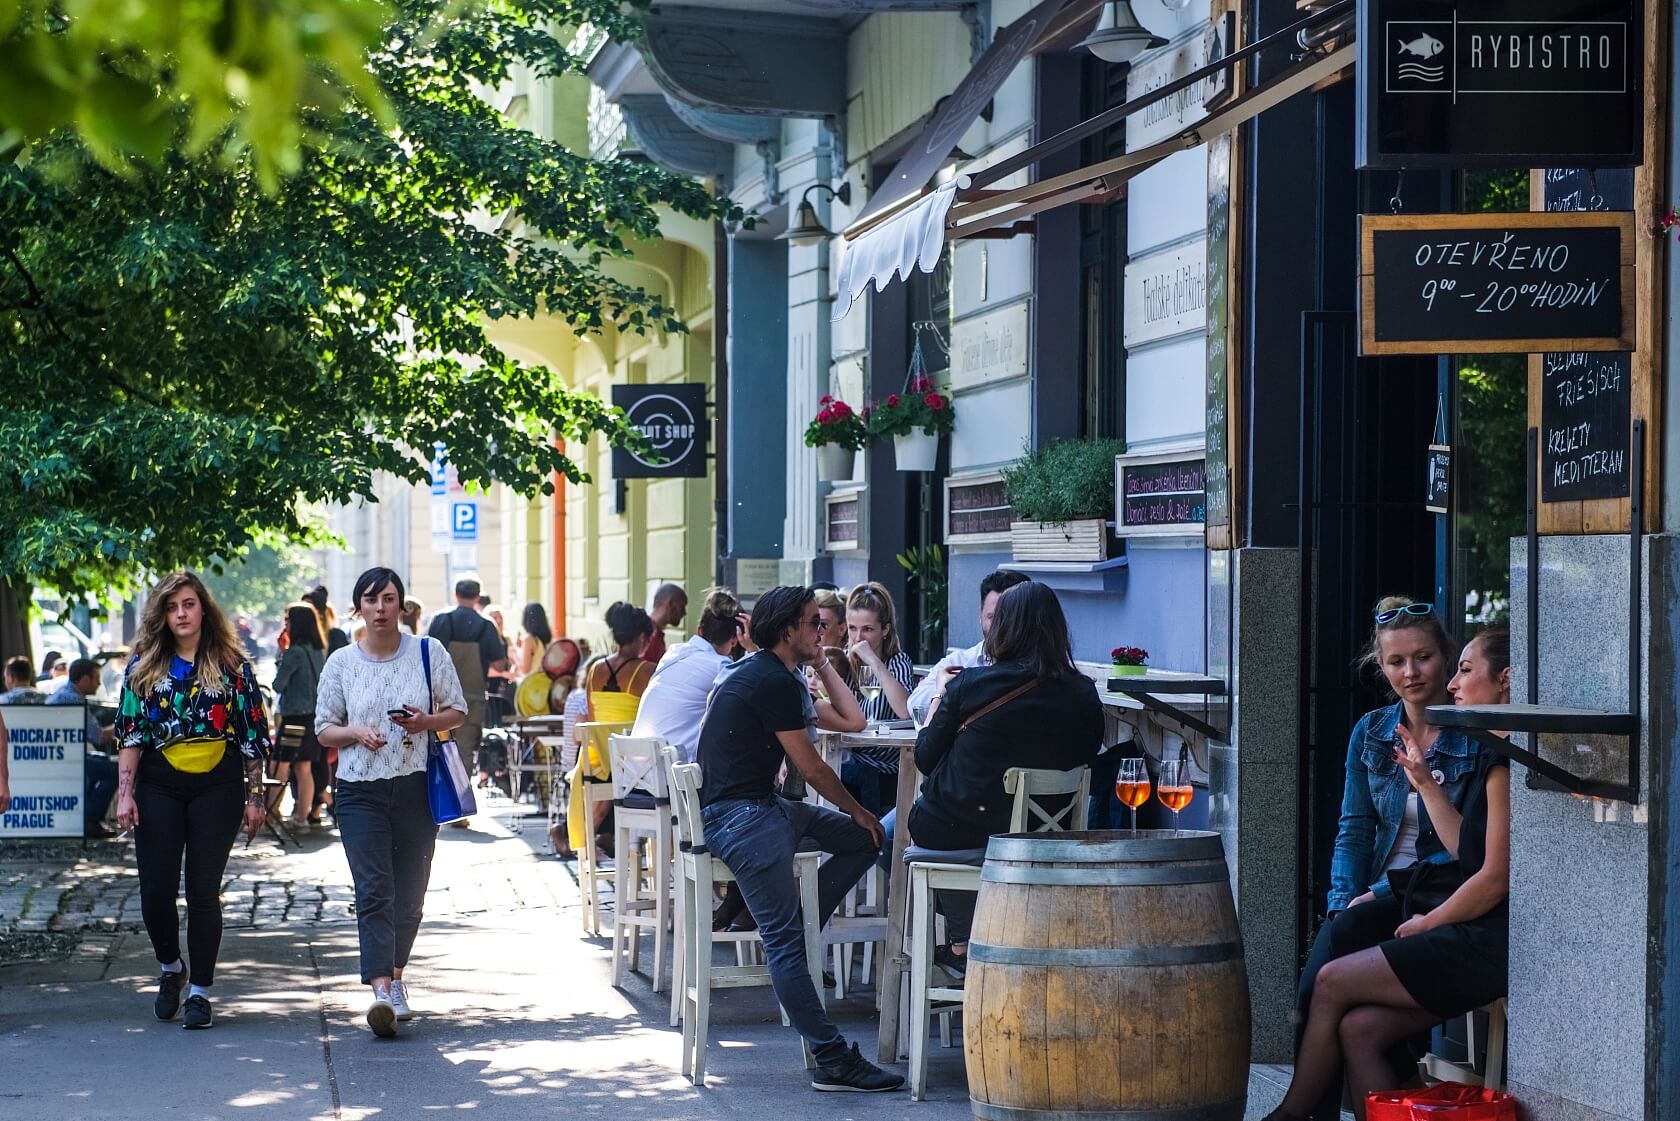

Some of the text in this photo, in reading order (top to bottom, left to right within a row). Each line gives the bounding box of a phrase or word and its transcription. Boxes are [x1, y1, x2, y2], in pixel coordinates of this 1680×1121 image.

[1471, 35, 1610, 68] RYBISTRO
[1415, 232, 1569, 272] OTEVŘENO
[664, 425, 696, 439] SHOP
[1554, 449, 1624, 487] MEDITTERAN
[455, 504, 475, 530] P
[13, 745, 65, 760] DONUTS
[3, 813, 55, 829] PRAGUE
